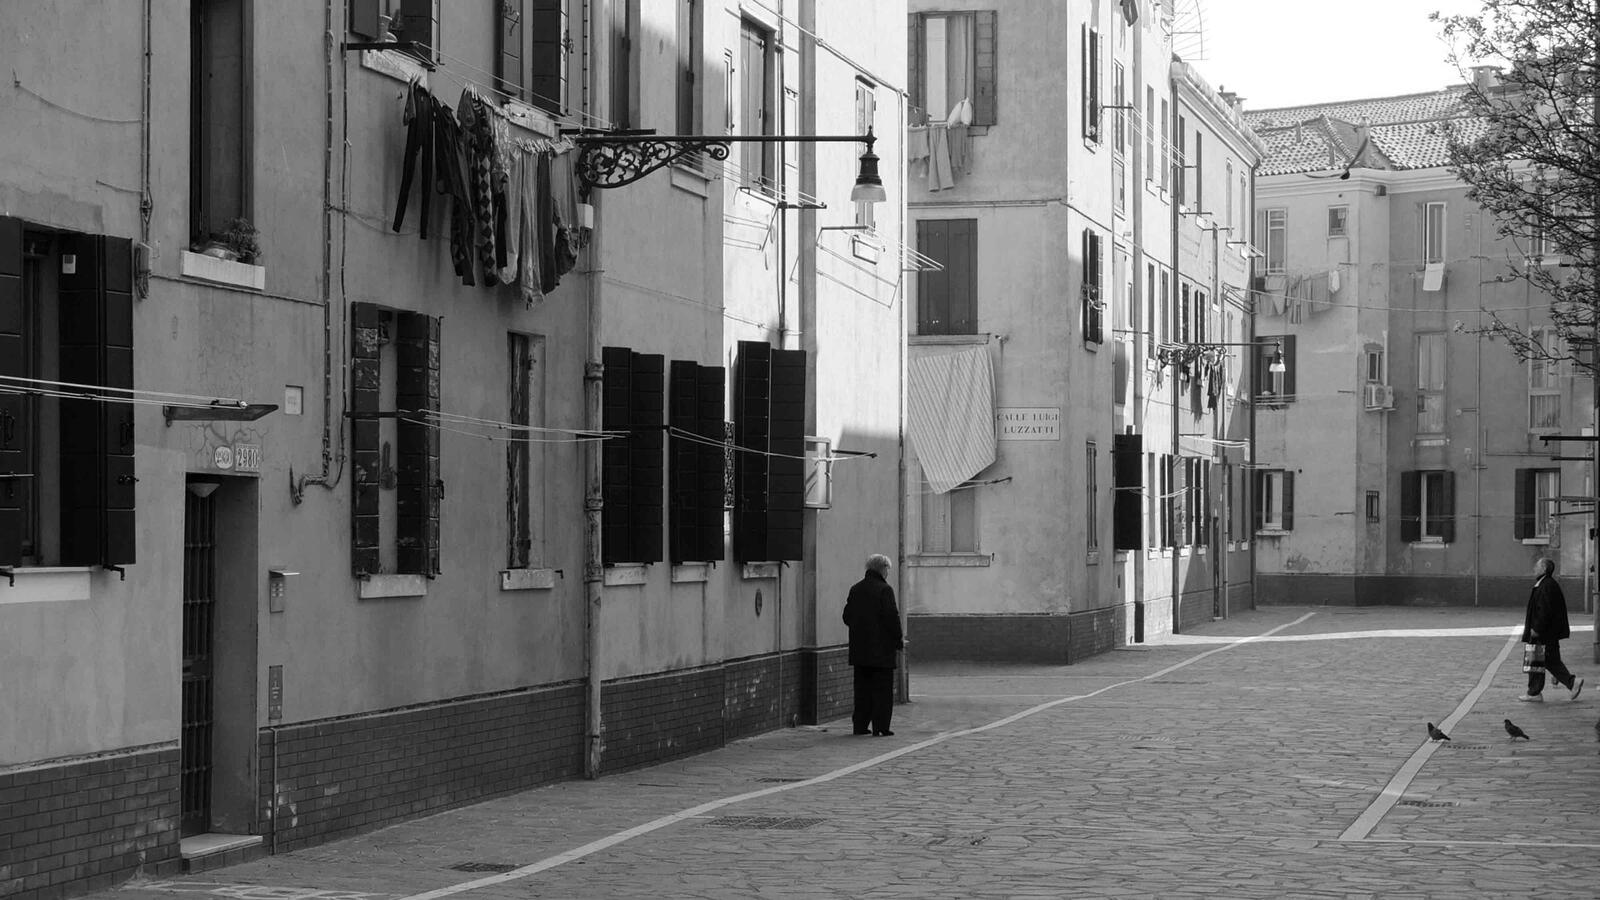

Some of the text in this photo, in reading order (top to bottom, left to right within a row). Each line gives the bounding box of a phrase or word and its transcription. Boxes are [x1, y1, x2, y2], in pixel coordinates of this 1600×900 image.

[997, 413, 1058, 421] CALLE LUIGI
[1004, 425, 1053, 433] LUZZATTI
[237, 448, 258, 467] 2980
